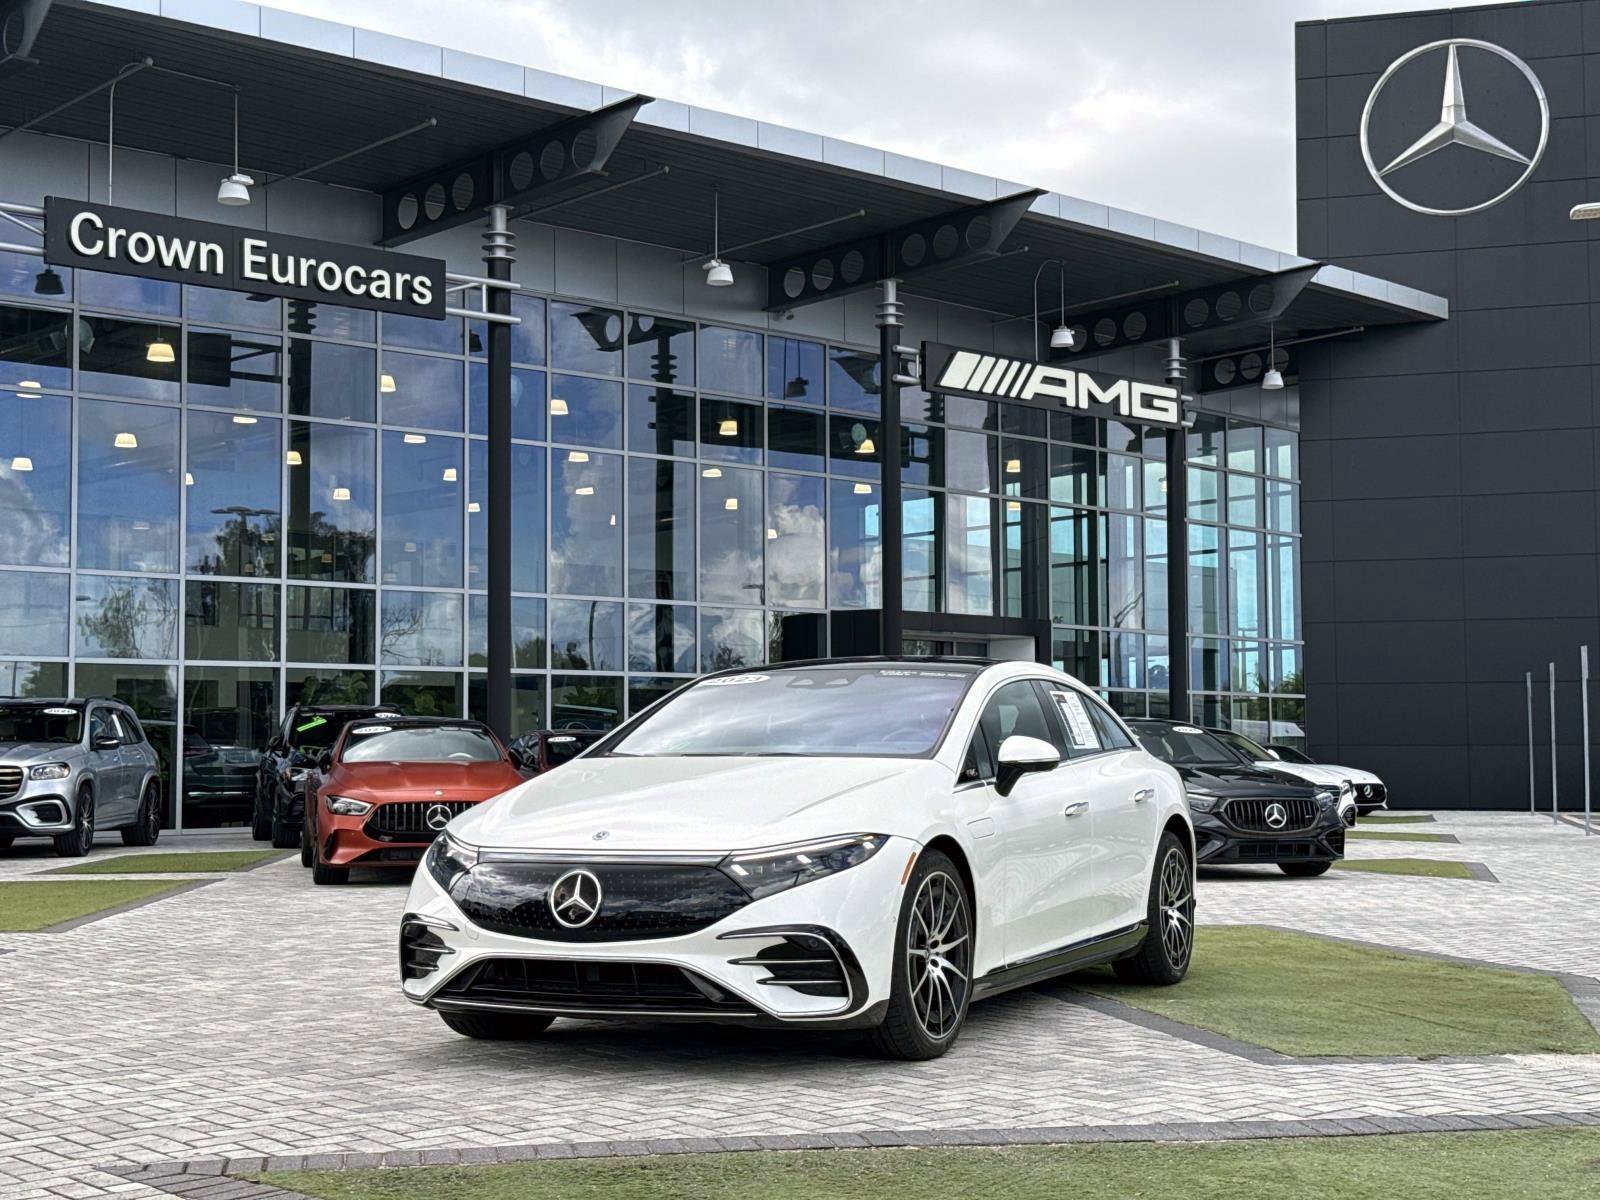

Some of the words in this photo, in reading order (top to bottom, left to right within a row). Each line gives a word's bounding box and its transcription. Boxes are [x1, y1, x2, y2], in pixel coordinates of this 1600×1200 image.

[70, 211, 224, 275] Crown
[243, 237, 433, 305] Eurocars
[1020, 364, 1178, 424] AMG
